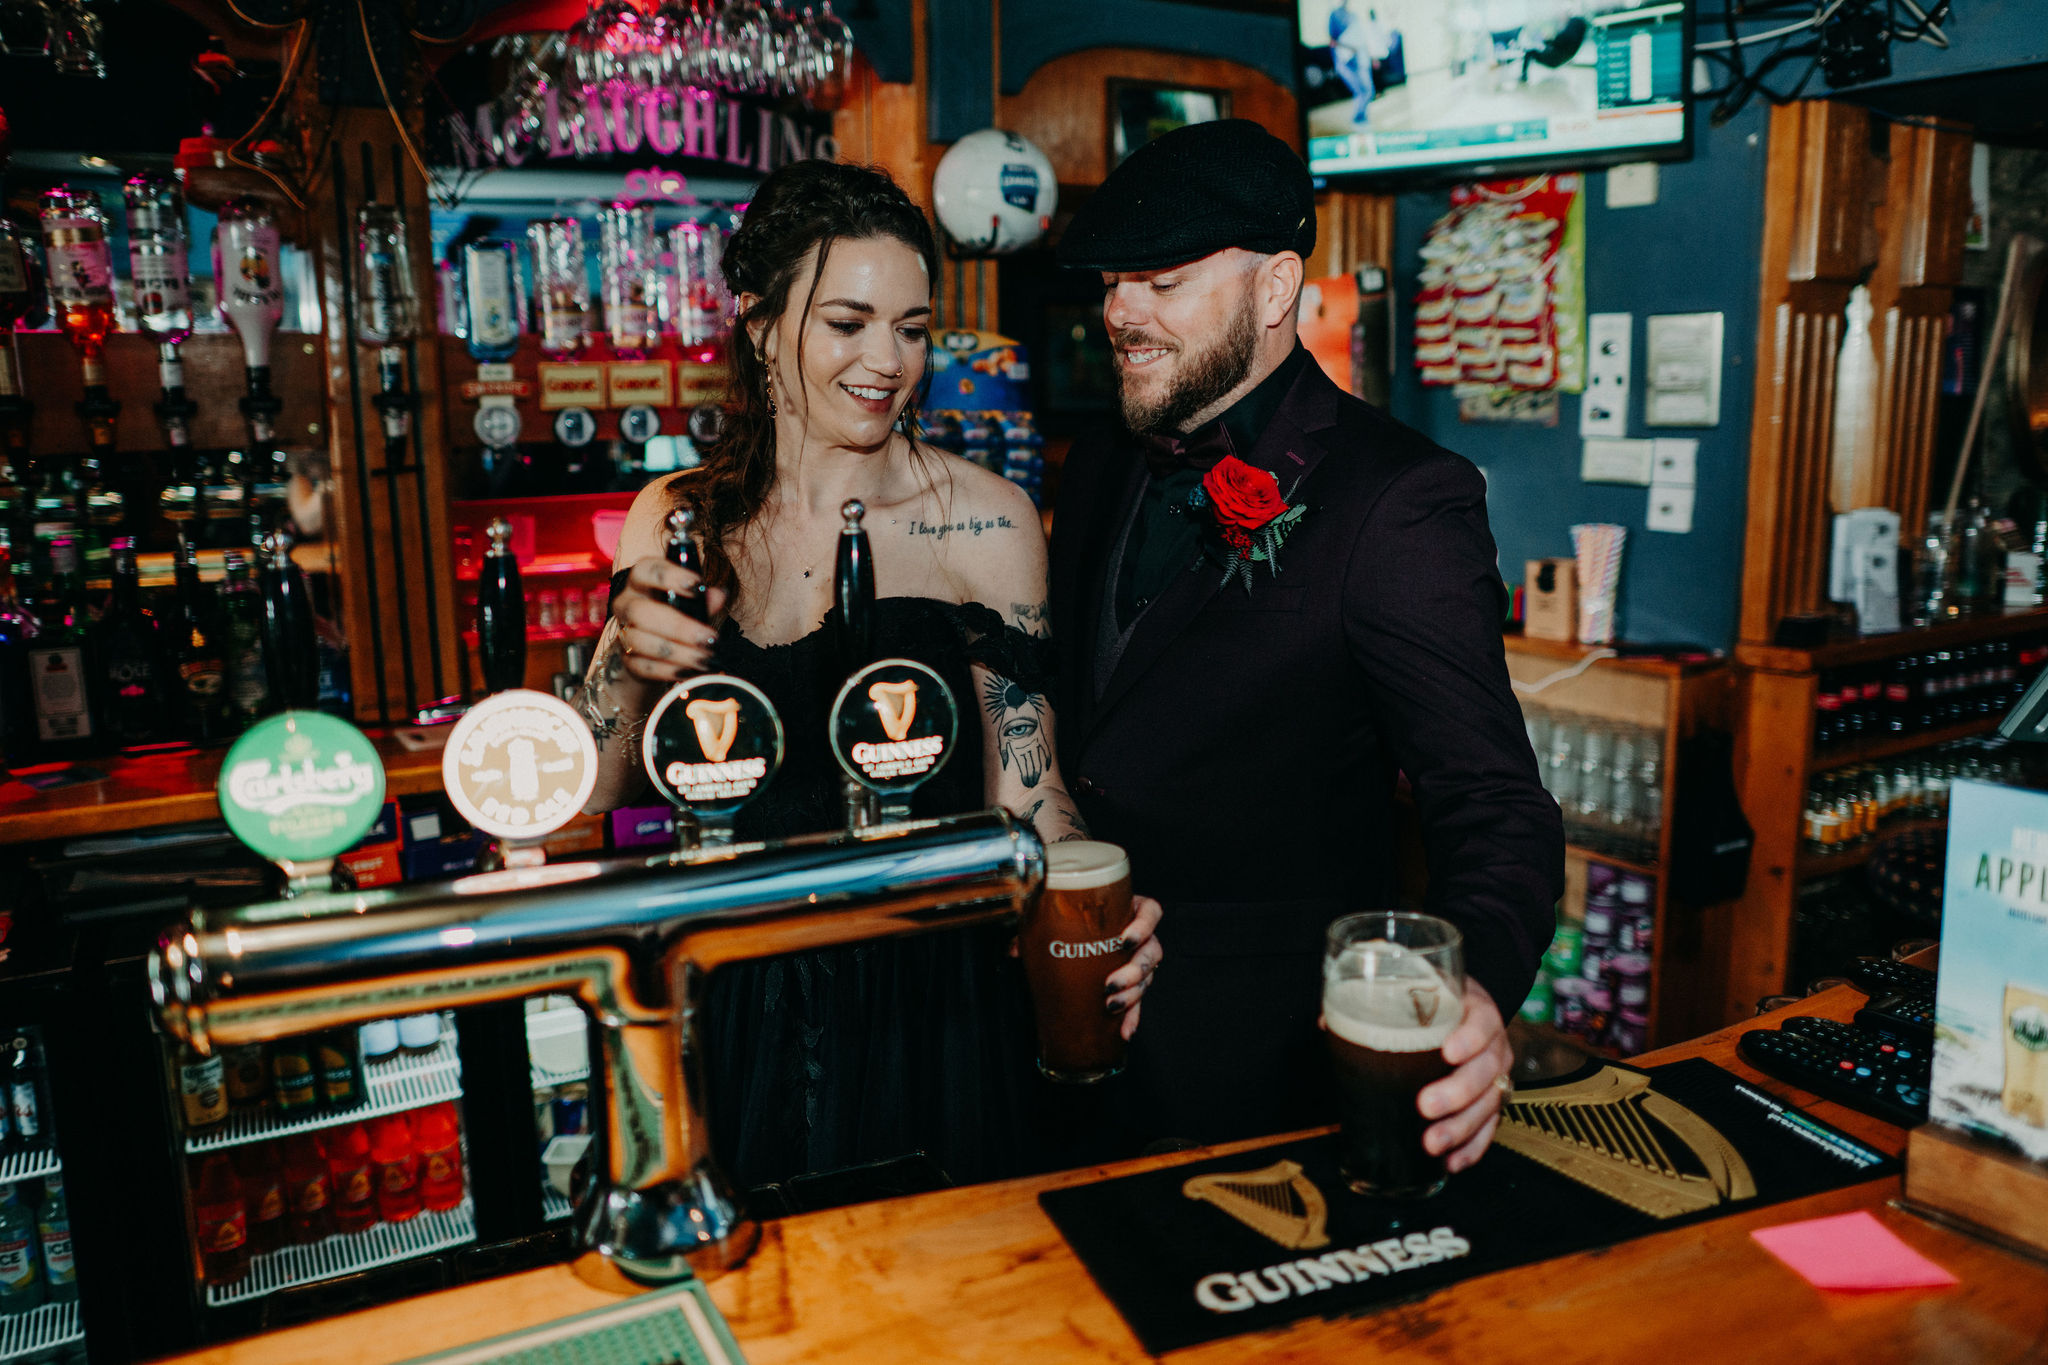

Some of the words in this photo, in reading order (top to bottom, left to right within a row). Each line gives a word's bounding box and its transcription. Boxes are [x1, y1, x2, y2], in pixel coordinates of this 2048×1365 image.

[909, 521, 916, 535] I
[919, 521, 936, 534] love
[937, 523, 954, 540] you
[957, 522, 965, 531] as
[969, 516, 983, 536] big
[985, 521, 994, 529] as
[852, 735, 943, 764] GUINNESS
[229, 751, 375, 812] Carlsberg
[666, 757, 766, 786] GUINNESS
[1049, 936, 1125, 959] GUINNES
[0, 1251, 21, 1267] CE
[1195, 1226, 1471, 1314] GUINNESS
